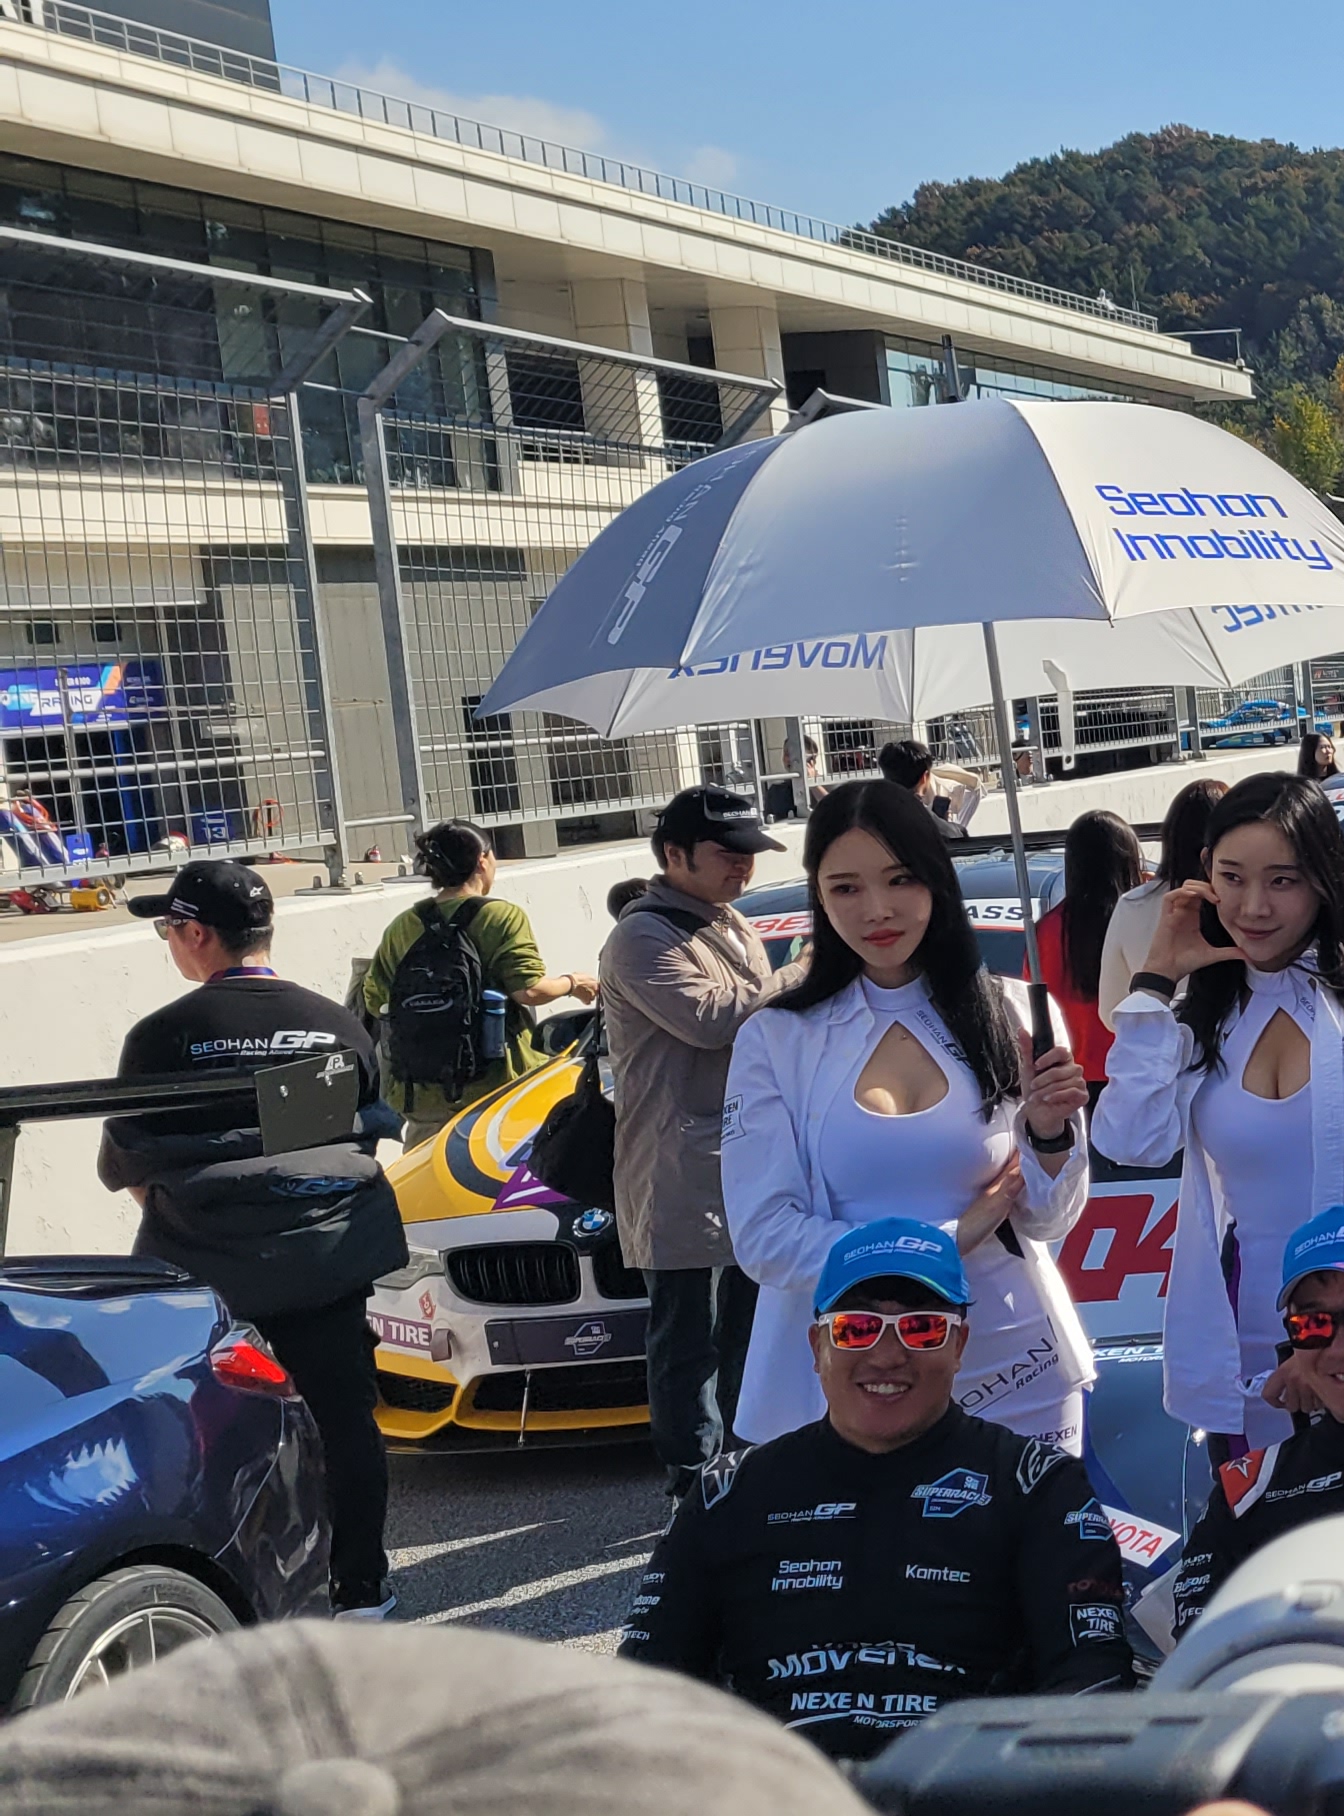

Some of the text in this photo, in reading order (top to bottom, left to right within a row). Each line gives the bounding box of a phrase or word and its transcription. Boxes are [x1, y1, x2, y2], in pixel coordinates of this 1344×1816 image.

[1095, 485, 1288, 519] Seohan
[1113, 528, 1334, 571] Innobility
[42, 694, 93, 709] RAING
[967, 904, 1023, 921] ASS
[190, 1030, 338, 1056] SEOHAN GP
[844, 1239, 897, 1262] SEOHAN
[894, 1235, 944, 1254] GP
[1293, 1230, 1337, 1257] SEOHAN
[387, 1320, 431, 1347] TIRE
[960, 1338, 1053, 1409] OHAN
[1013, 1352, 1058, 1390] Racing
[1265, 1471, 1344, 1500] SEOHAN GP
[766, 1502, 858, 1522] SEOHAN GP
[1107, 1517, 1164, 1559] YOTA
[778, 1559, 843, 1575] Seohan
[905, 1563, 971, 1584] Kamtec
[770, 1573, 844, 1592] Innobility
[1086, 1619, 1116, 1634] TIRE
[790, 1692, 938, 1713] NEXEN TIRE
[852, 1715, 922, 1729] MOTORSPOR
